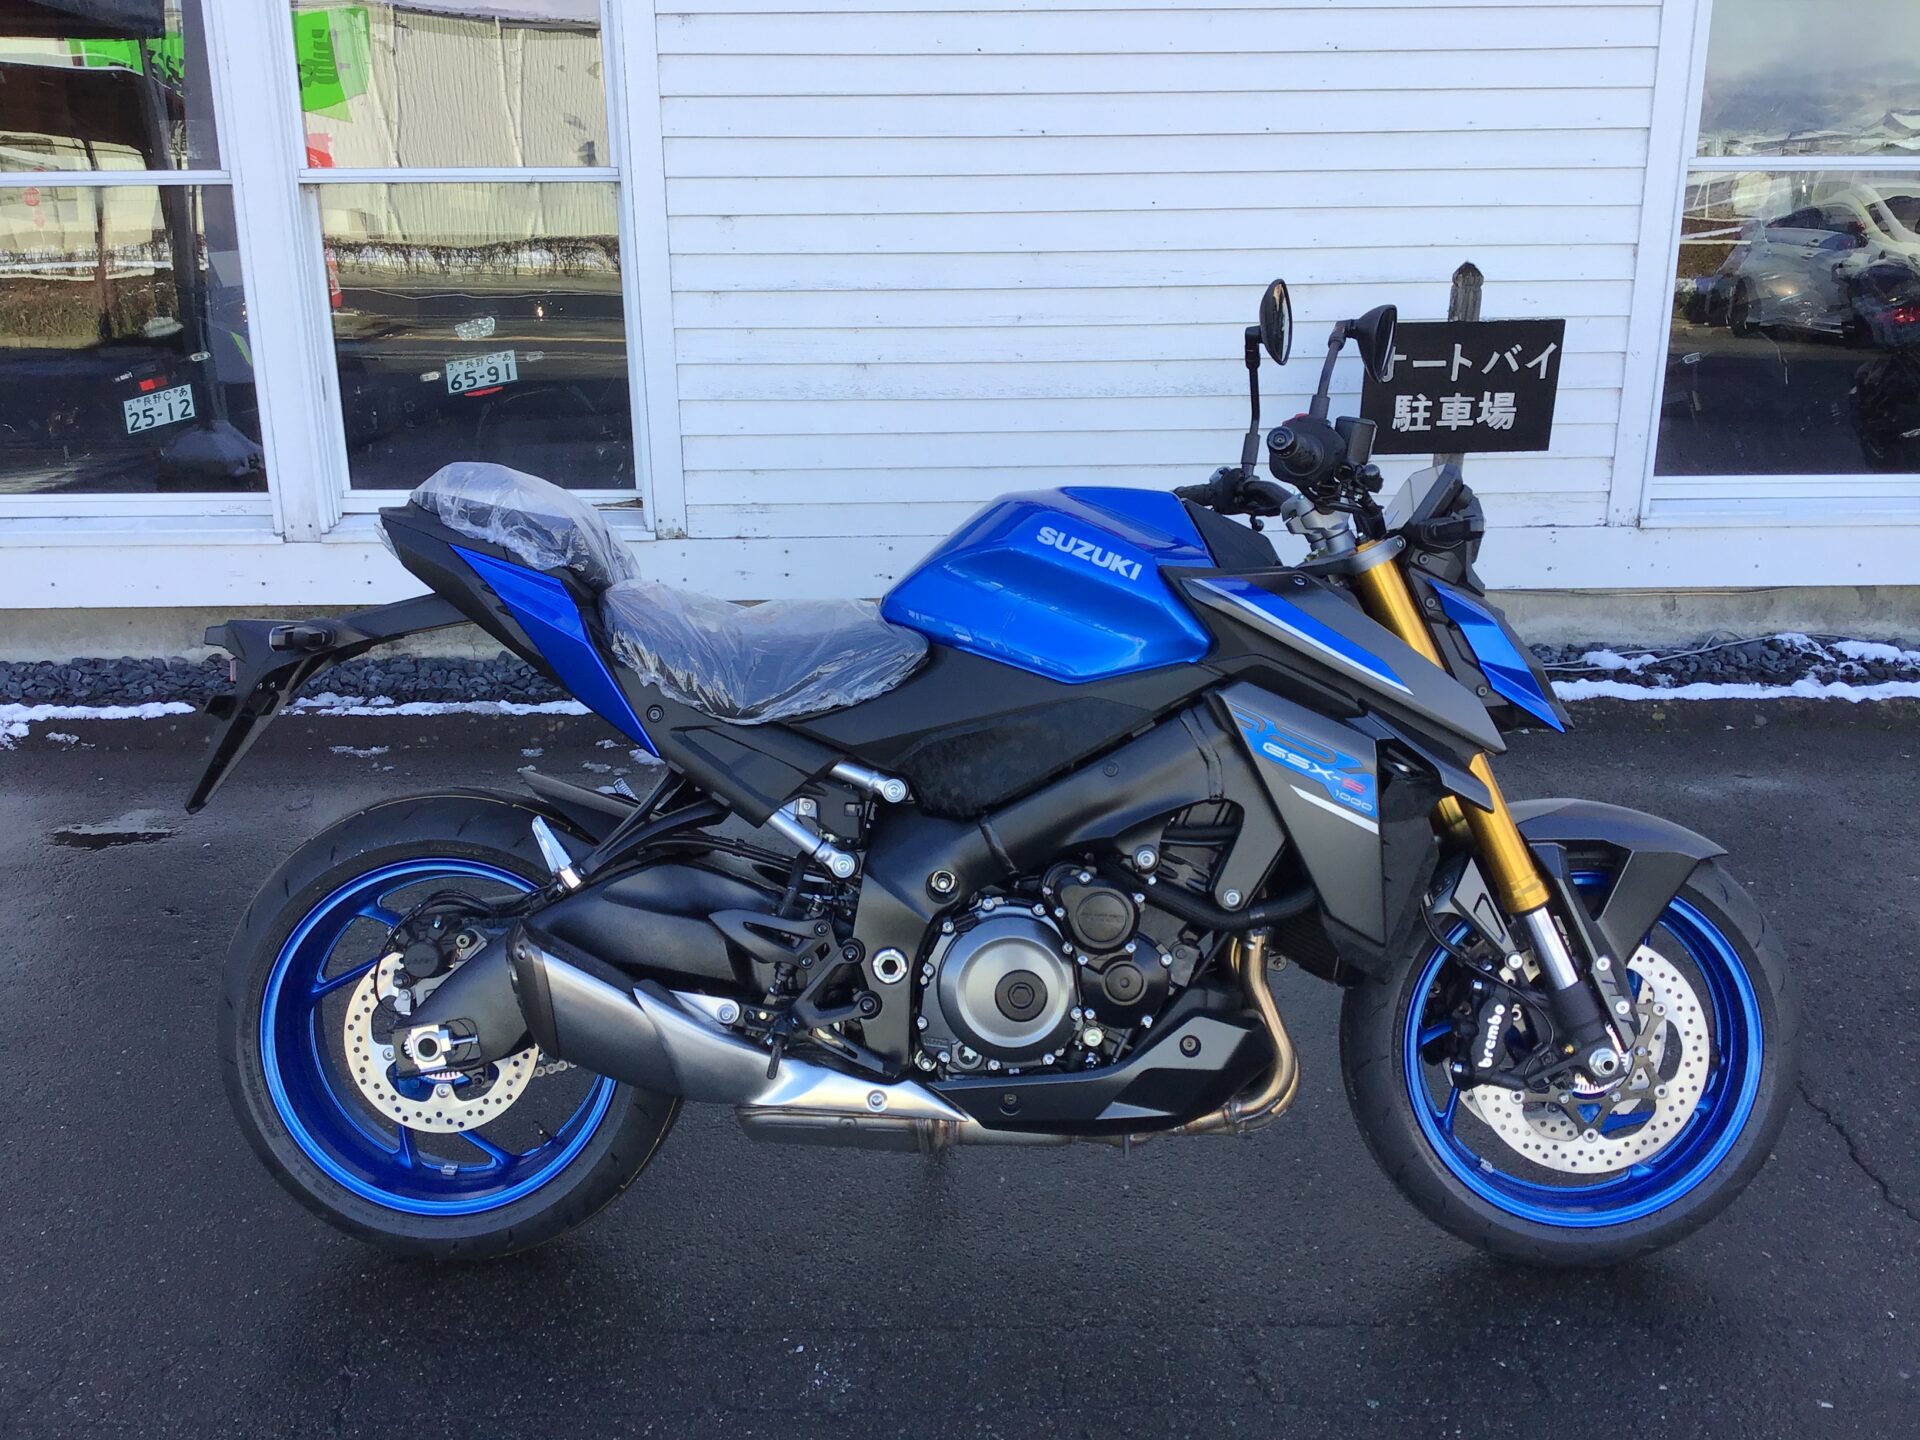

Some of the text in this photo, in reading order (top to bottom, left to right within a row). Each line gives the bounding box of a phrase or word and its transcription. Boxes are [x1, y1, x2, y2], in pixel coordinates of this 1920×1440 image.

[450, 363, 512, 391] 65-91
[129, 399, 192, 431] 25-12
[1392, 391, 1517, 433] 駐車場
[1036, 526, 1142, 581] SUZUKI
[1263, 742, 1364, 793] GSX-S
[1335, 789, 1373, 812] 1000
[1478, 1004, 1505, 1068] brembo
